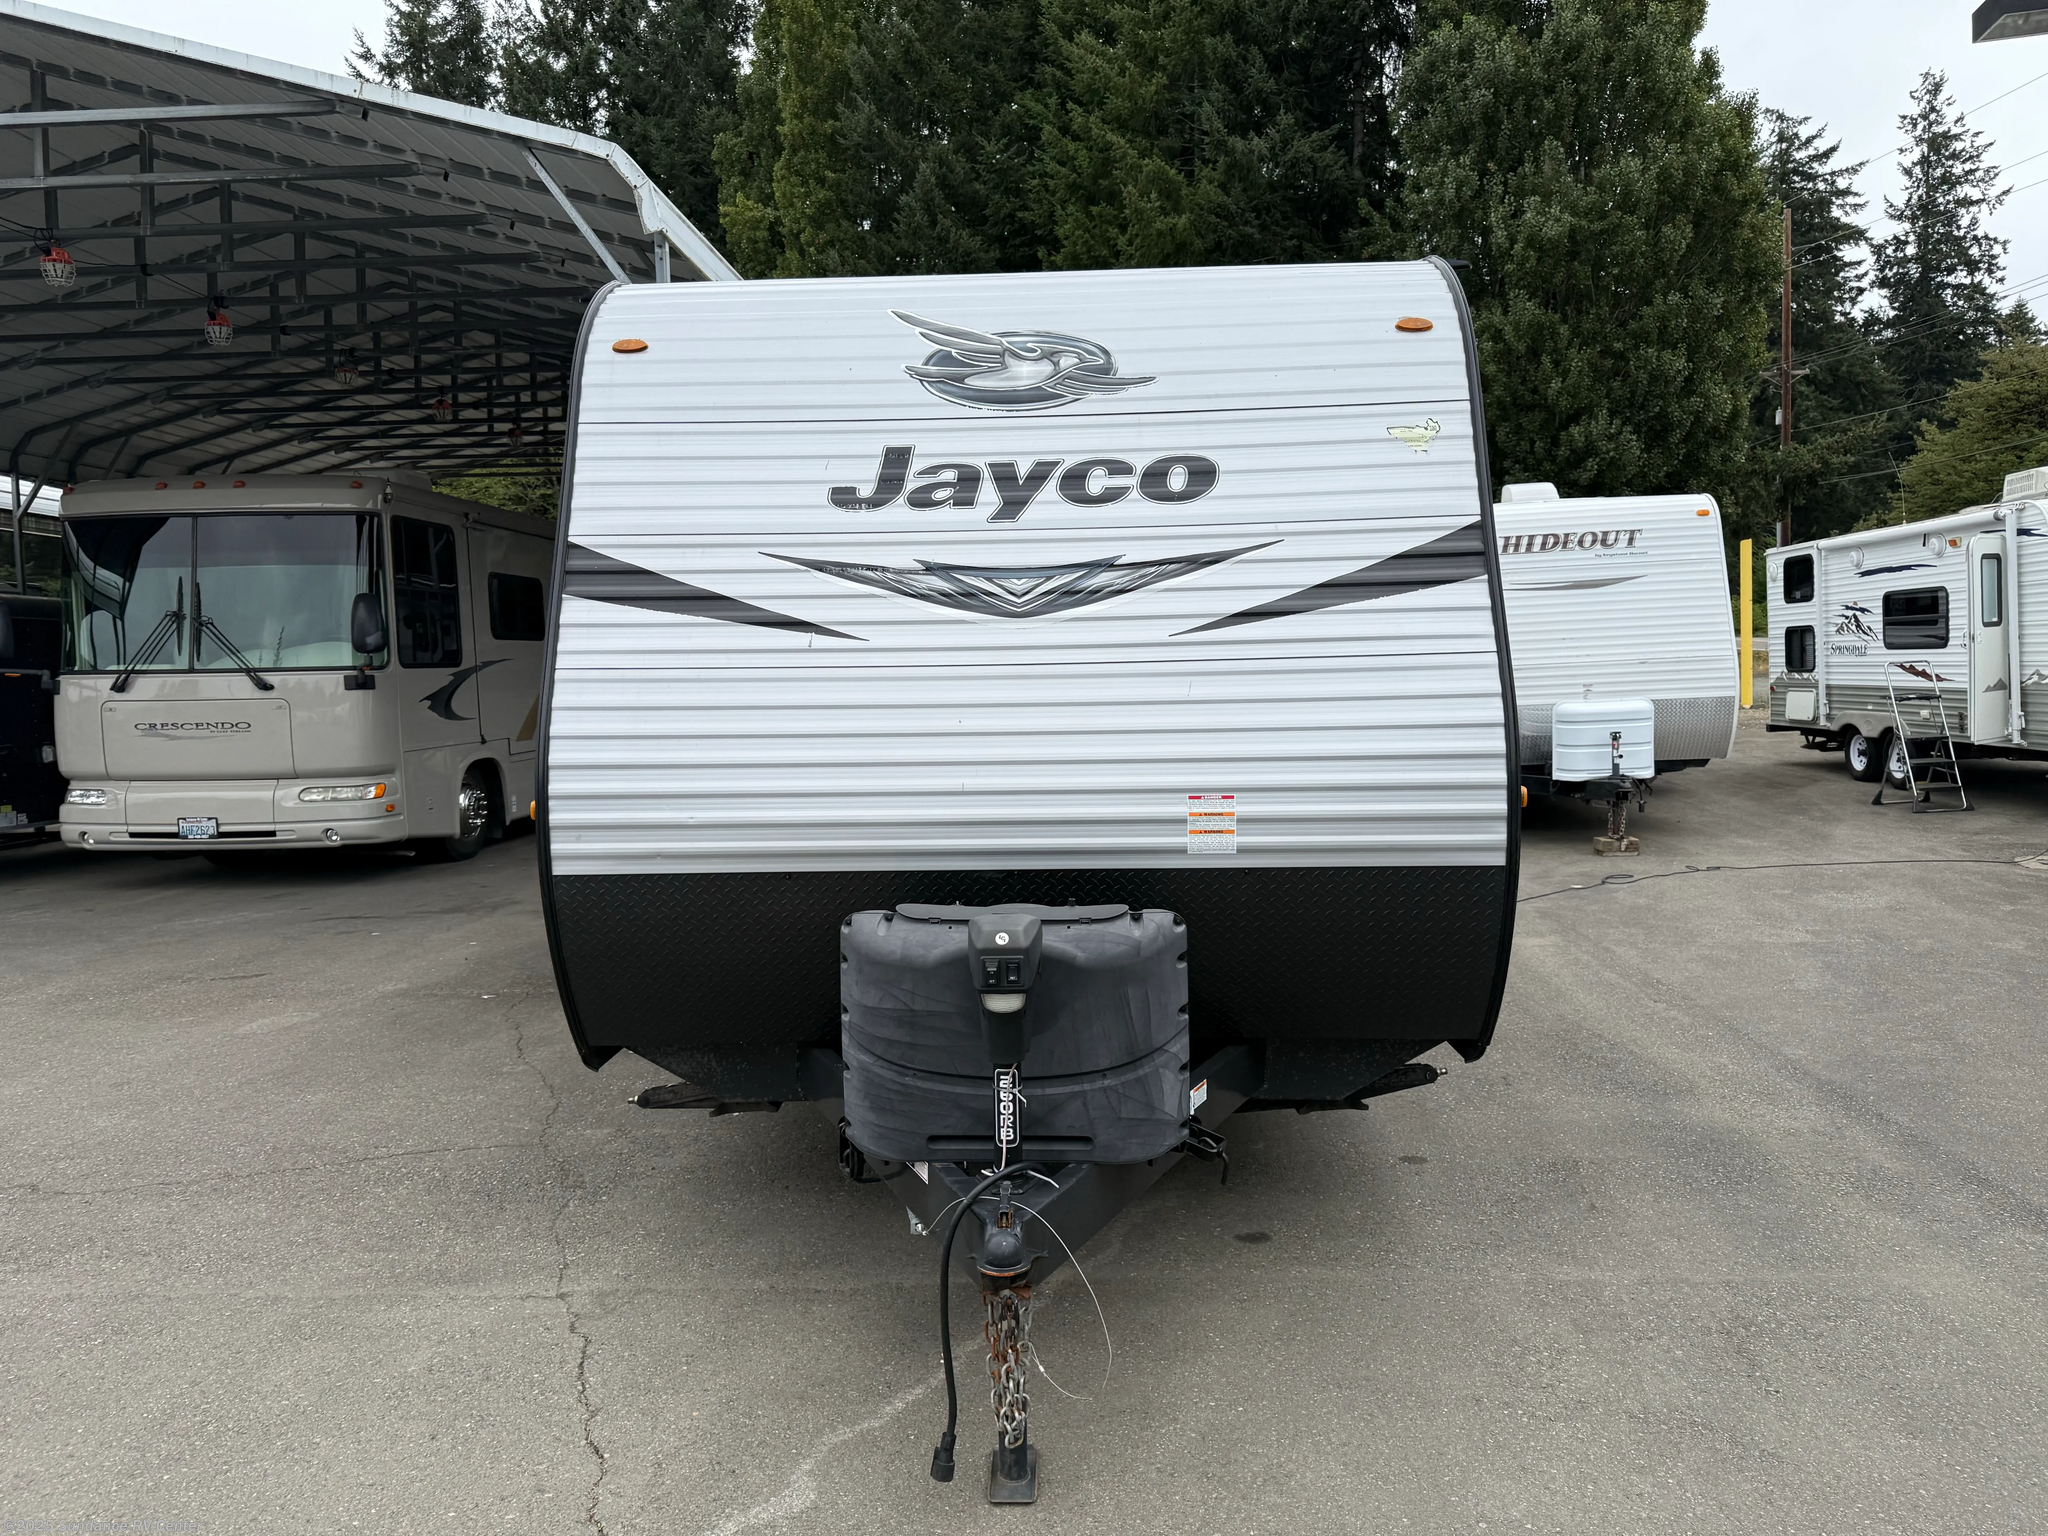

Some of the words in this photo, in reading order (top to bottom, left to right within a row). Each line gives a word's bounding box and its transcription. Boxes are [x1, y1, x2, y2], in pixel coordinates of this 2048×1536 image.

[828, 444, 1220, 523] Jayco
[1499, 528, 1643, 556] HIDEOUT
[134, 721, 251, 731] CRESCENDO
